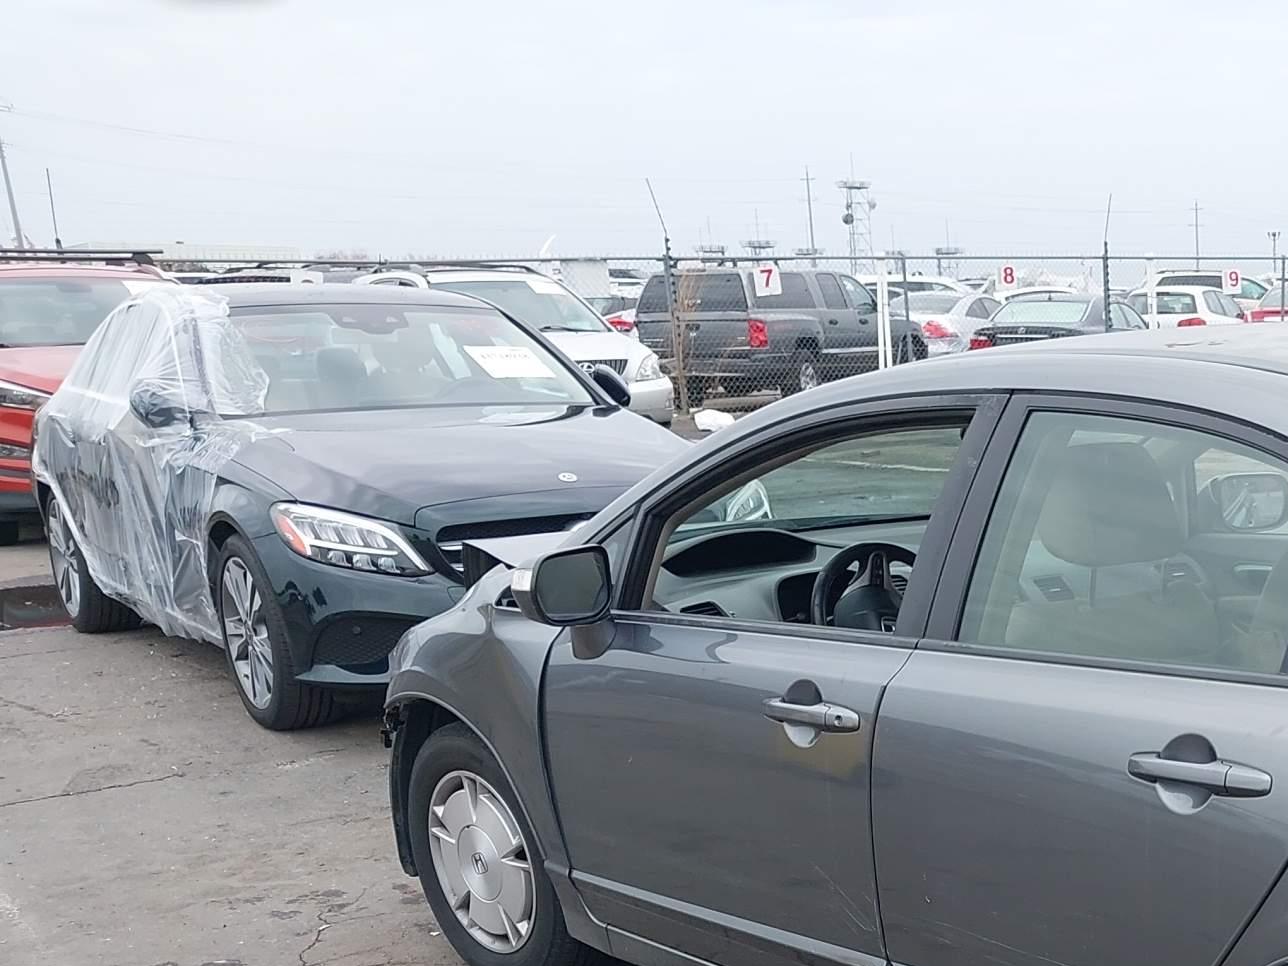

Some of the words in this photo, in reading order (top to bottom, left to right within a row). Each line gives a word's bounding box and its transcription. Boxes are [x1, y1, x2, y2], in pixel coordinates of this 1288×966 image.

[760, 268, 773, 288] 7
[1003, 266, 1015, 285] 8
[1228, 271, 1239, 287] 9
